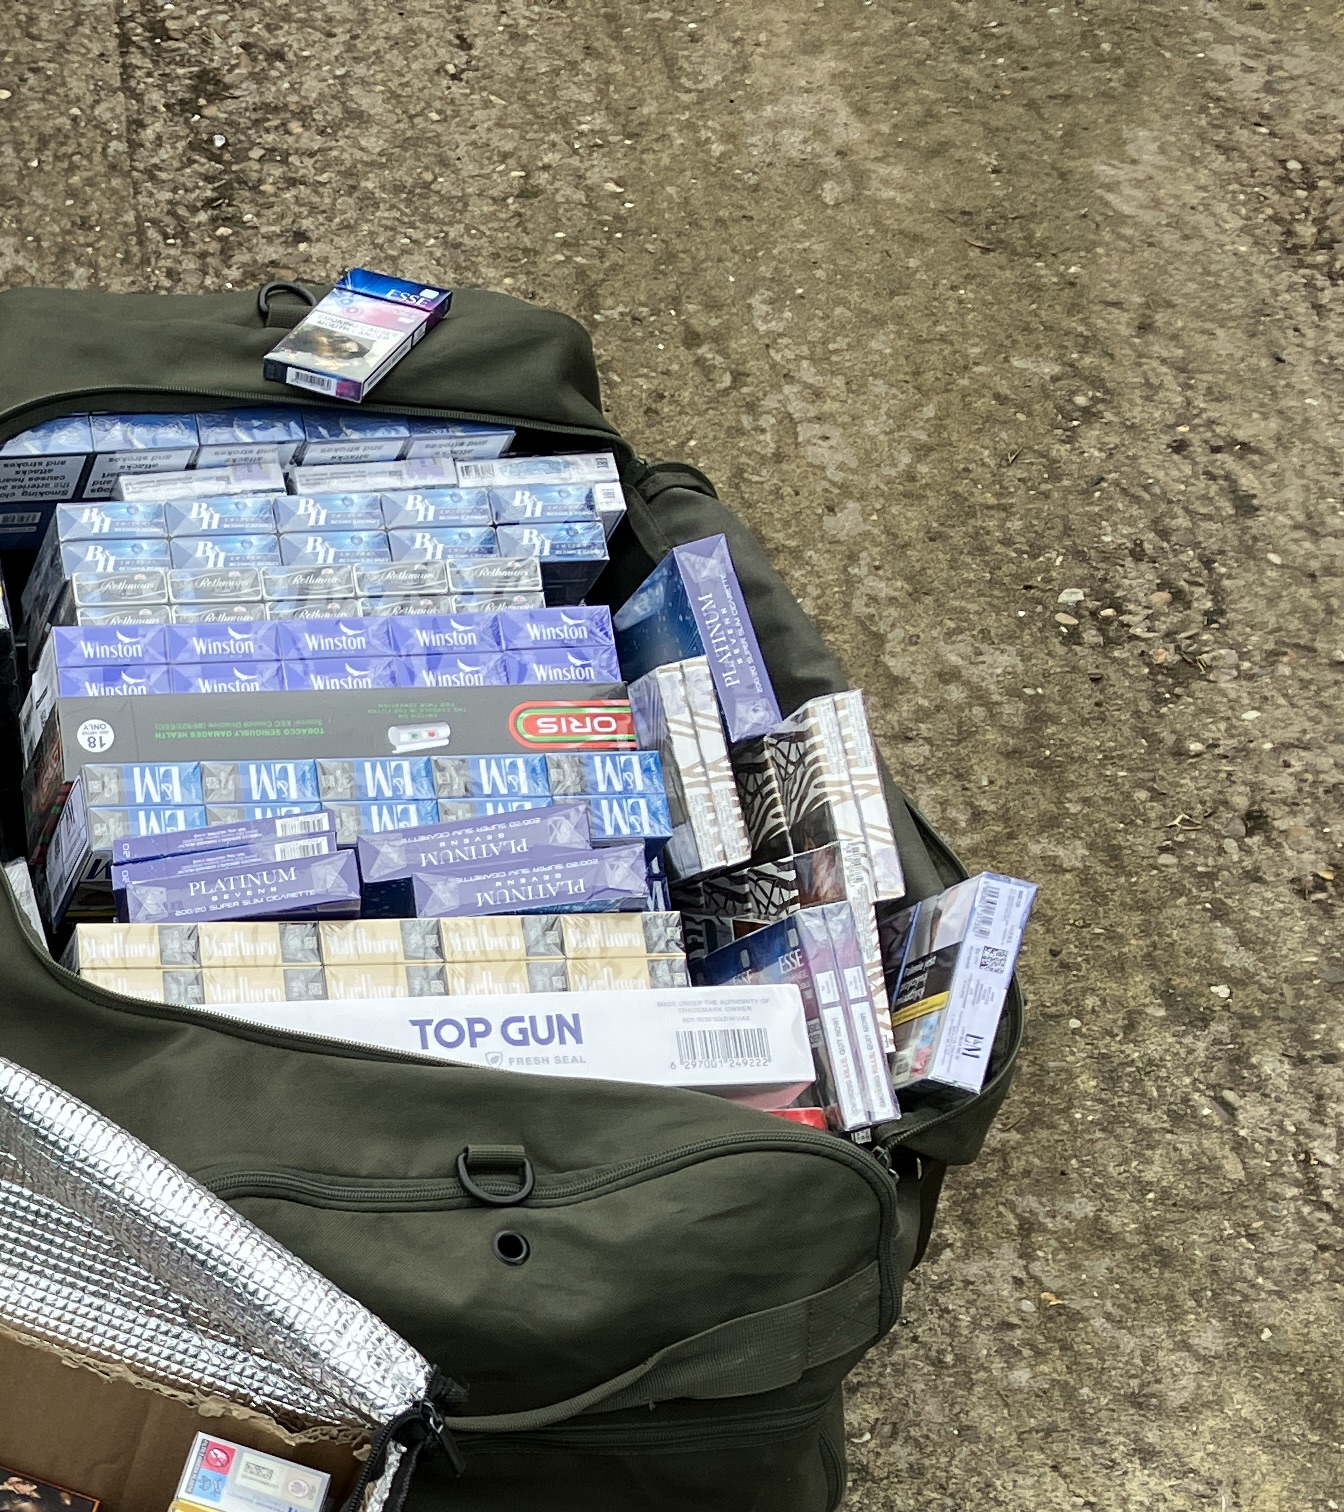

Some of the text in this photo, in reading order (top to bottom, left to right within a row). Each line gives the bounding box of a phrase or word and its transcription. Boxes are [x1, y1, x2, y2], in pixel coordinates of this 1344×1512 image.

[386, 289, 432, 306] ESSE
[305, 632, 366, 650] Winston
[416, 630, 477, 647] Winston
[527, 624, 588, 640] Winston
[698, 593, 740, 687] PLATINUM
[81, 641, 142, 659] Winston
[192, 637, 254, 655] Winston
[533, 664, 595, 682] Winston
[536, 717, 617, 734] ORIS
[87, 736, 106, 748] 18
[419, 838, 528, 867] PLATINUM
[188, 867, 297, 895] PLATINUM
[476, 878, 585, 906] PLATINUM
[569, 922, 641, 948] Marlboro
[83, 932, 156, 958] Marlboro
[205, 932, 277, 957] Marlboro
[779, 950, 803, 974] ESSE
[409, 1013, 583, 1050] TOP GUN
[509, 1055, 586, 1066] FRESH SEAL
[683, 1057, 769, 1070] 297001 249222
